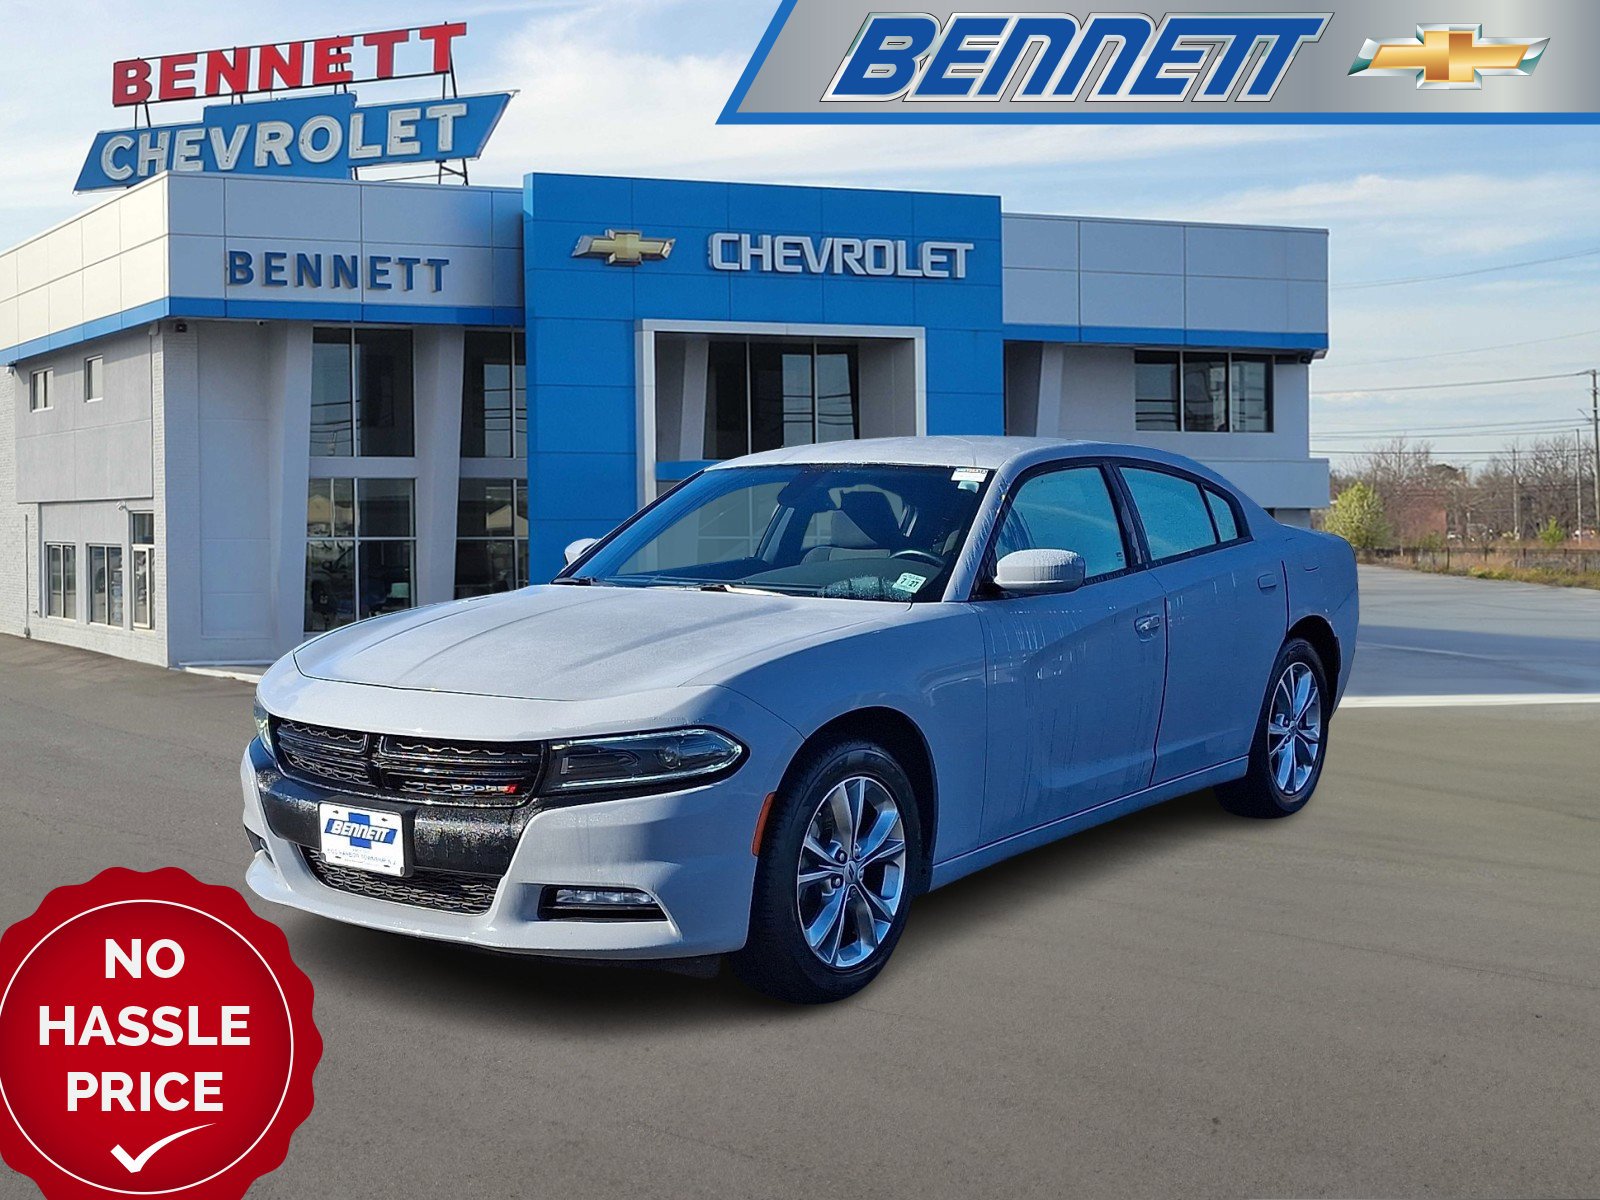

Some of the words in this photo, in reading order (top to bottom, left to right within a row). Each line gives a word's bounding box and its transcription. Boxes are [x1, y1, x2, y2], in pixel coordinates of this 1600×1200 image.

[113, 22, 467, 106] BENNETT
[100, 103, 468, 182] CHEVROLET
[226, 250, 450, 292] BENNETT
[708, 232, 975, 279] CHEVROLET
[330, 820, 391, 842] BENNETT
